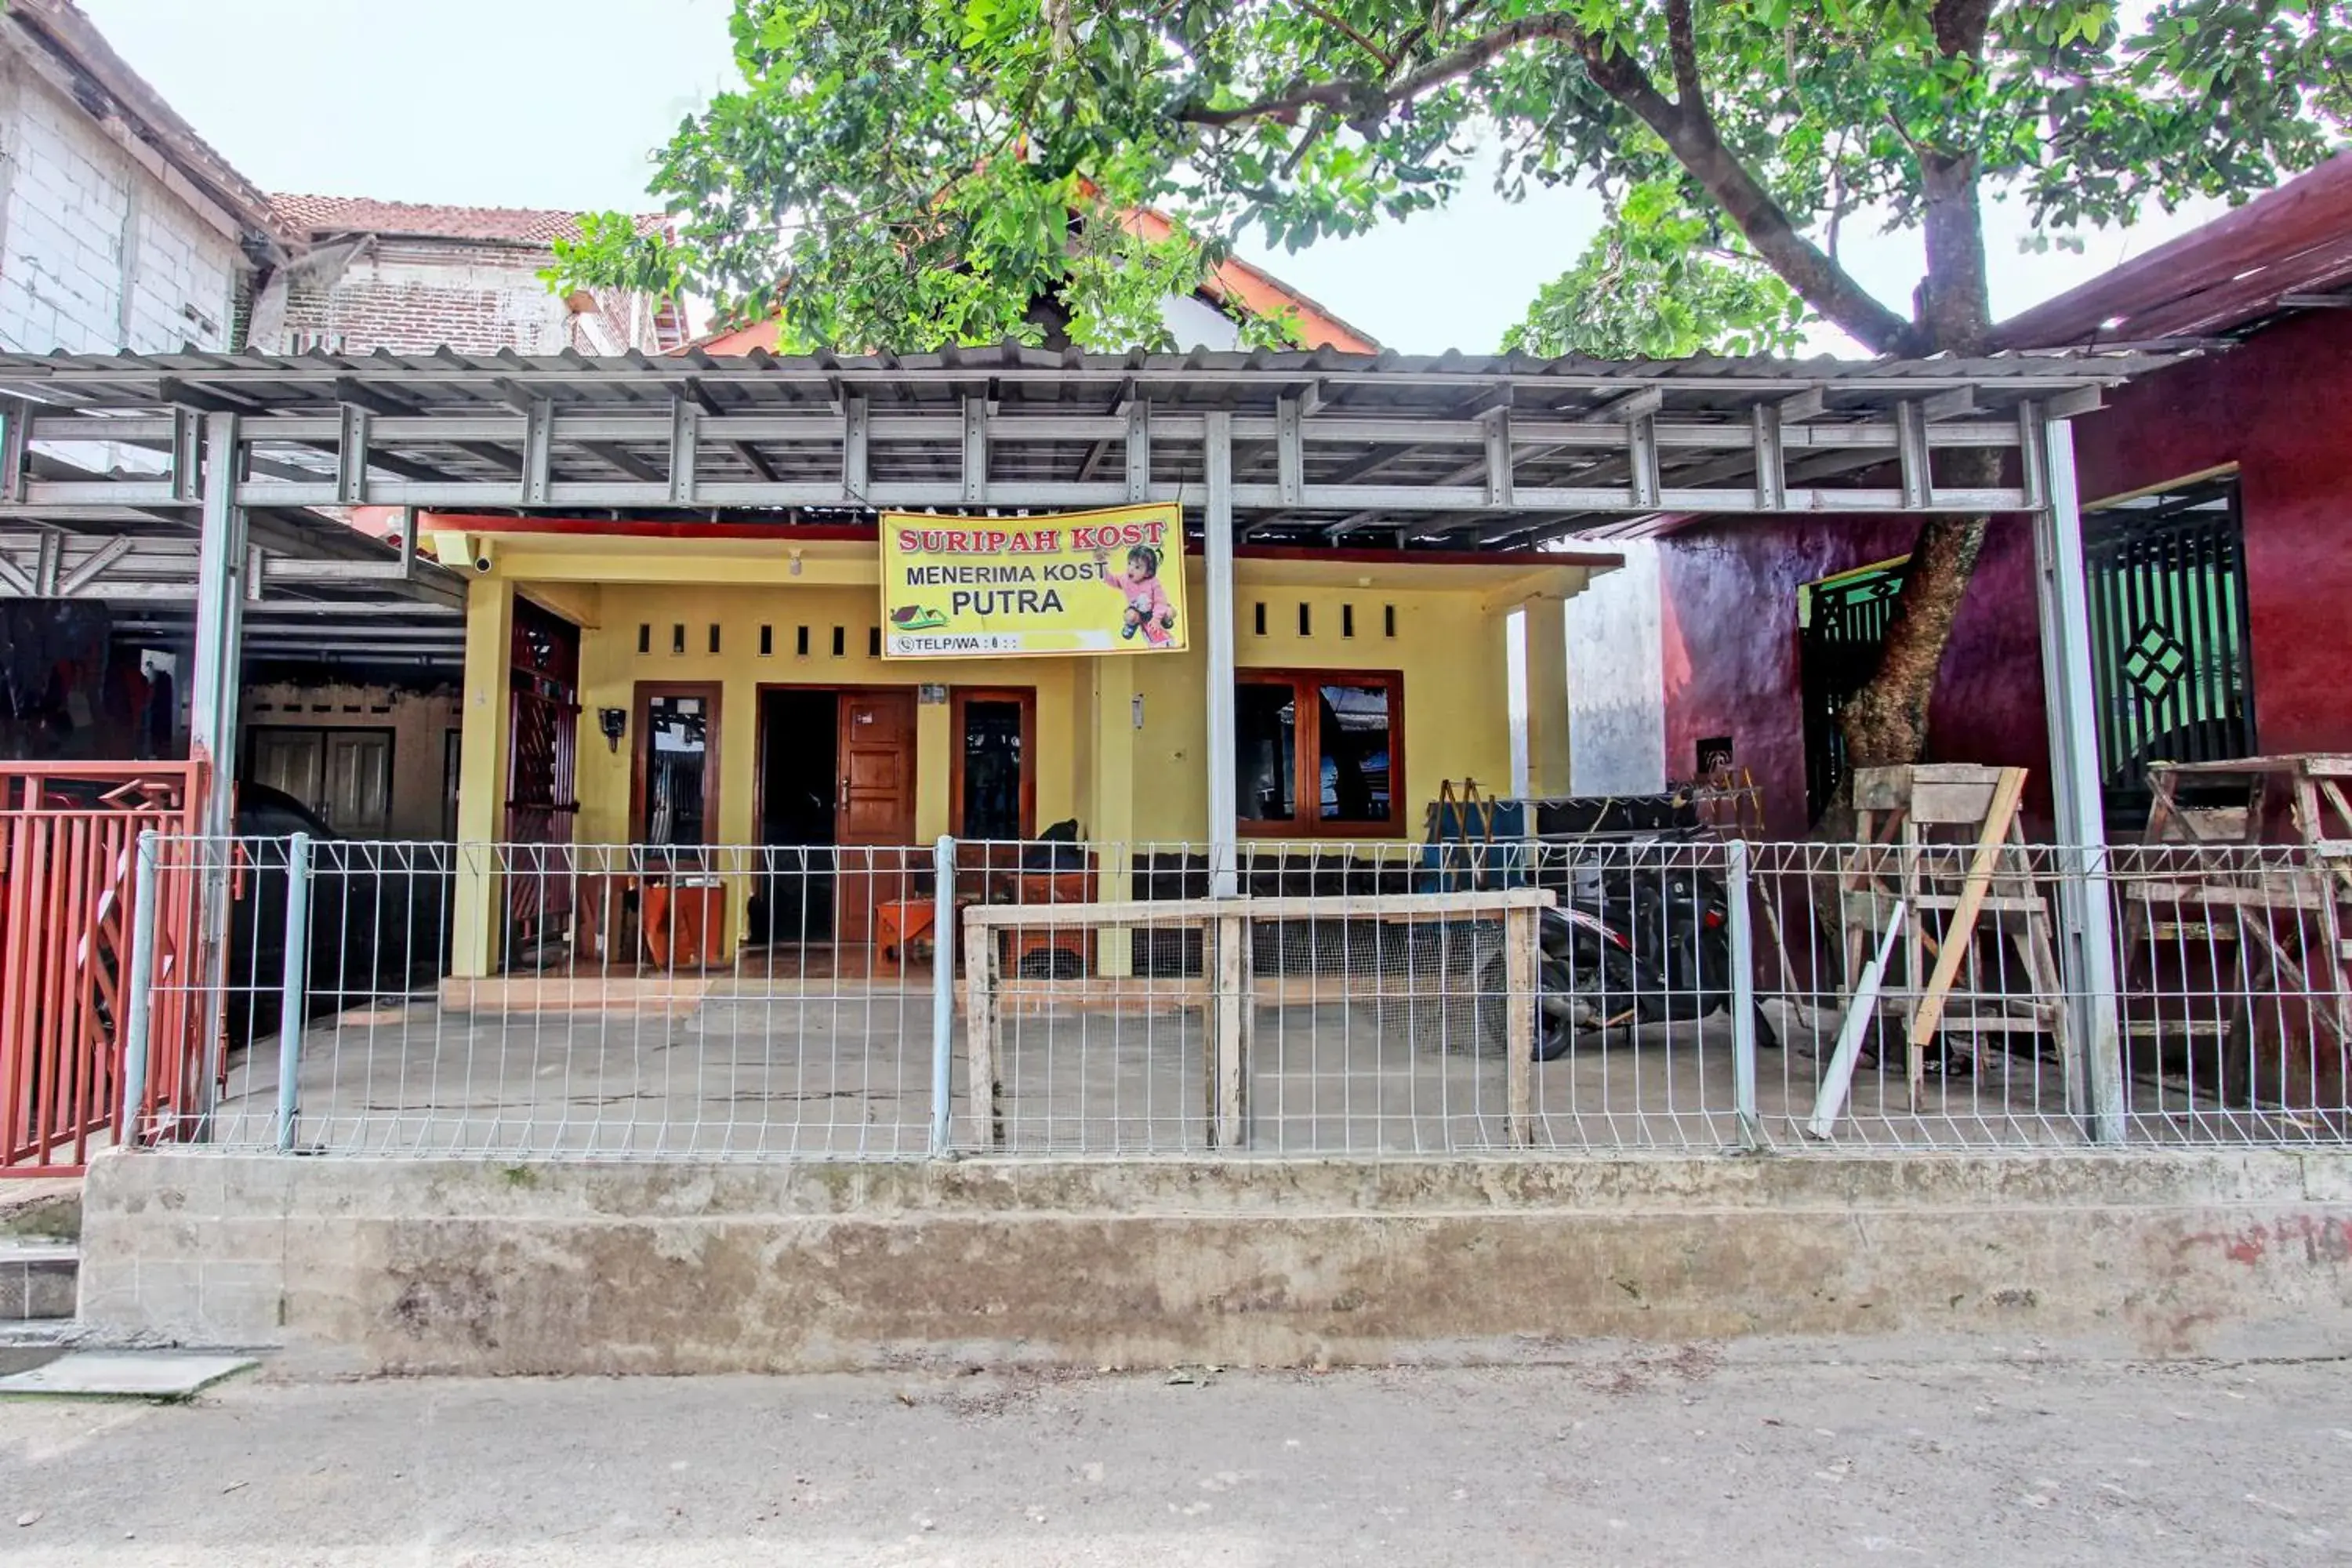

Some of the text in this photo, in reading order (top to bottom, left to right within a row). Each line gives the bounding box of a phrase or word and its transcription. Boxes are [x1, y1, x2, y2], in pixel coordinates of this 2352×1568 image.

[898, 521, 1165, 552] SURIPAH KOST
[906, 562, 1108, 585] MENERIMA KOST
[953, 590, 1064, 615] PUTRA
[915, 637, 979, 650] TELP/WA
